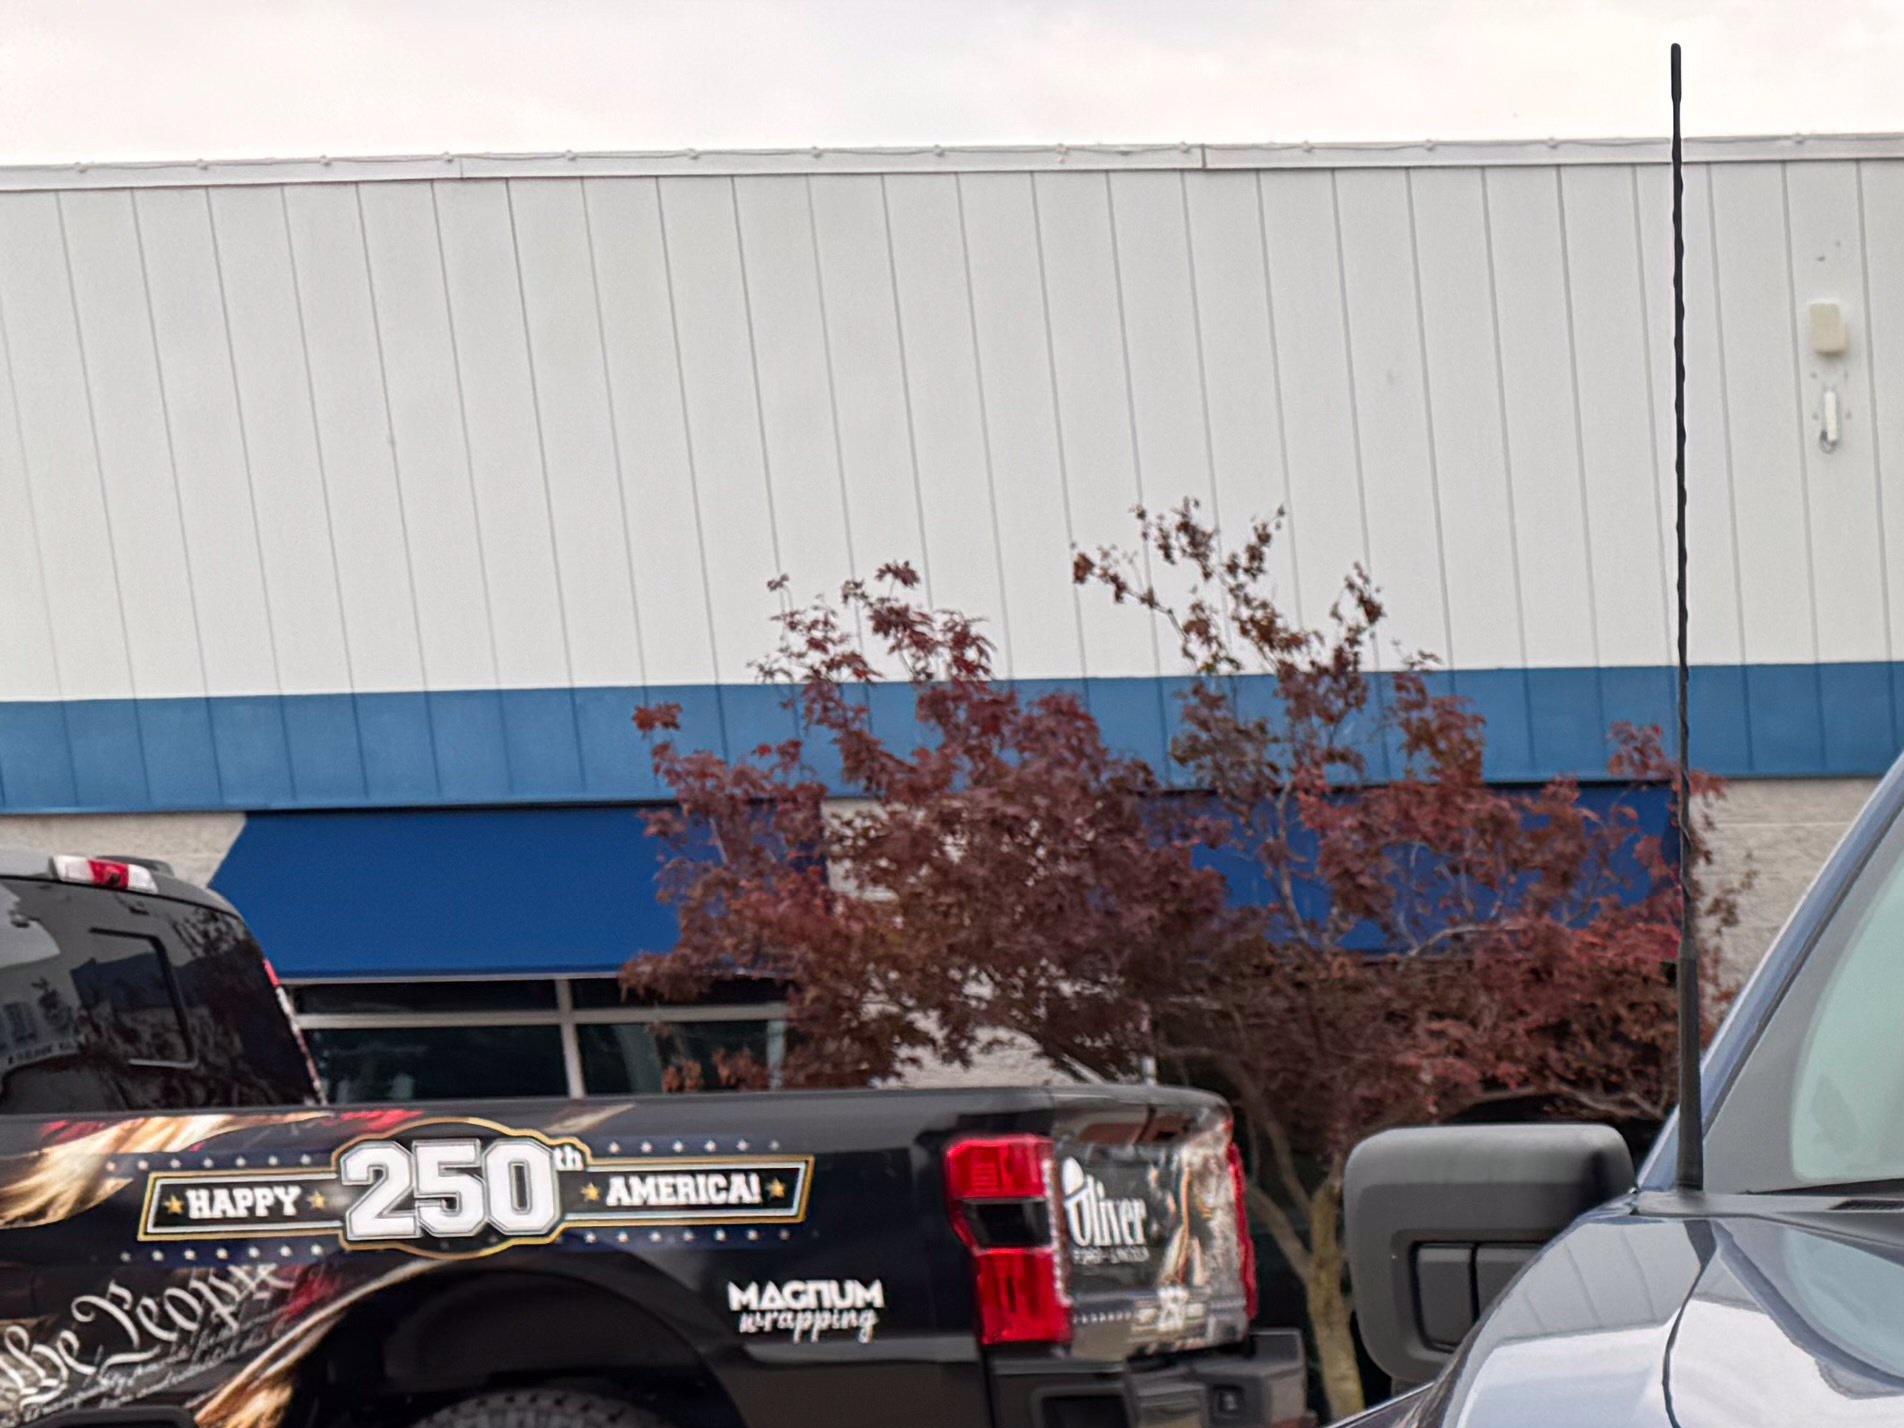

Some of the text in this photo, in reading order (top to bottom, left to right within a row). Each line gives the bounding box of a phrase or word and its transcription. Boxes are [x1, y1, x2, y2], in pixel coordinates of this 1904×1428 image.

[185, 1185, 302, 1220] HAPPY
[605, 1173, 763, 1207] AMERICA!
[1062, 1156, 1150, 1247] Oliver
[727, 1279, 884, 1311] MAGNUM
[738, 1306, 879, 1344] wrapping
